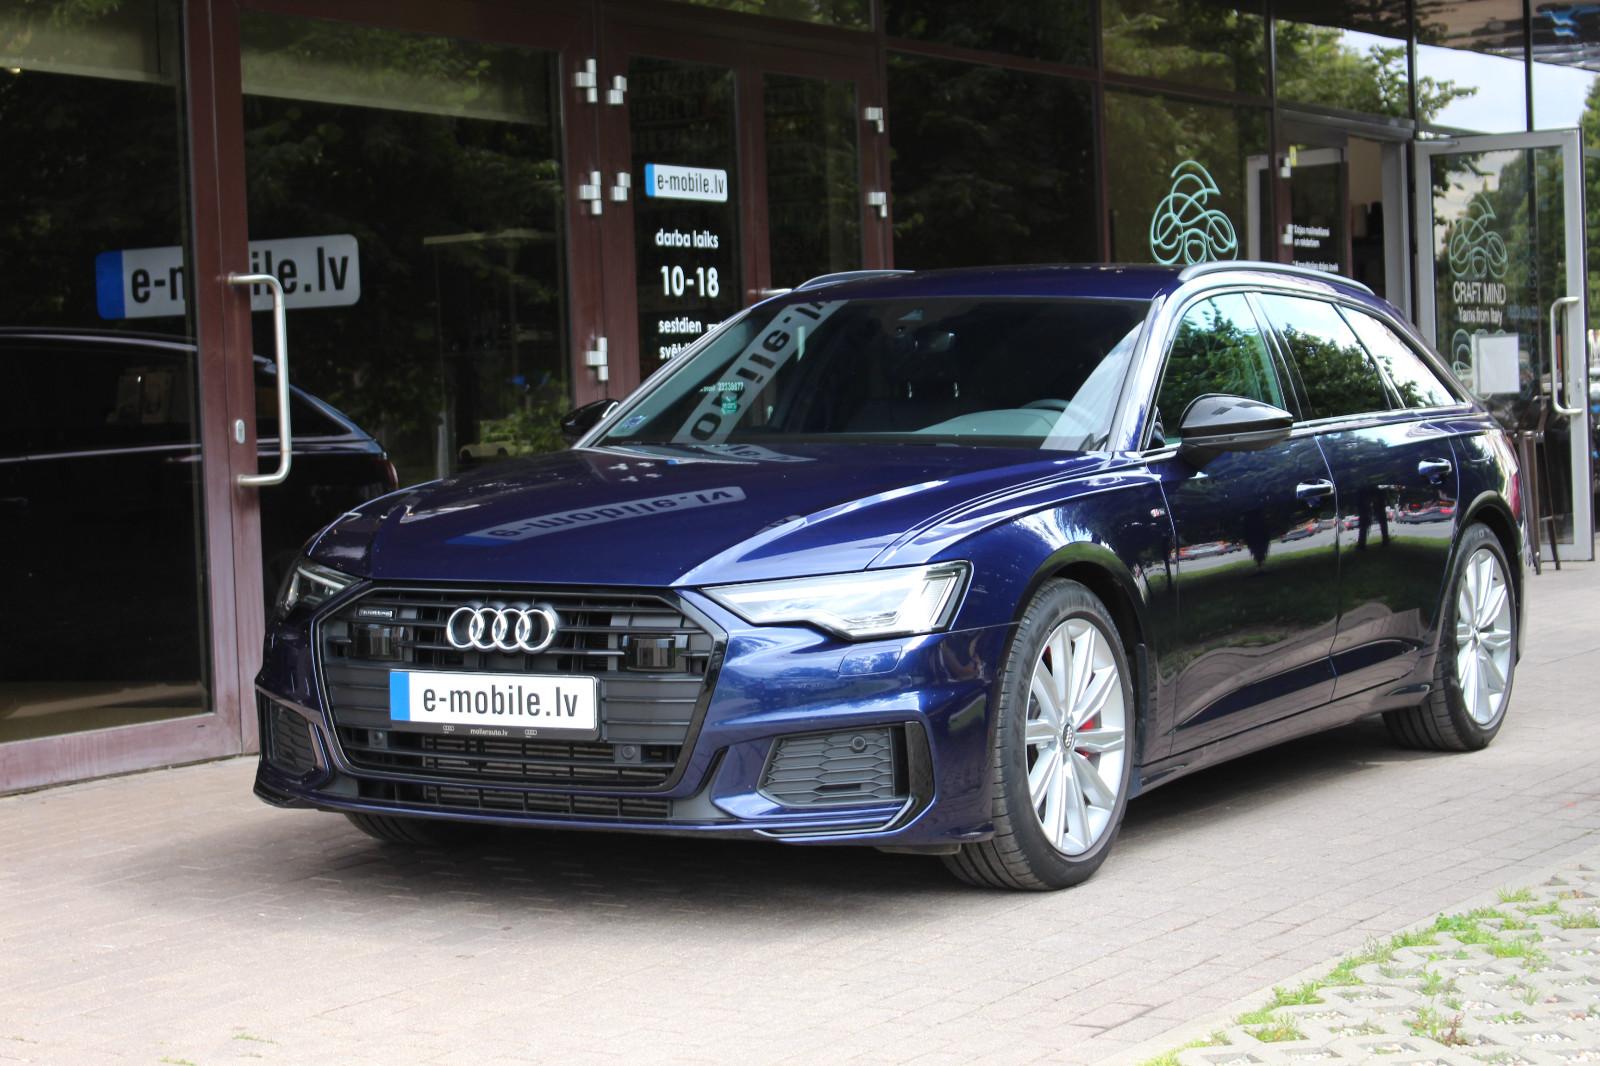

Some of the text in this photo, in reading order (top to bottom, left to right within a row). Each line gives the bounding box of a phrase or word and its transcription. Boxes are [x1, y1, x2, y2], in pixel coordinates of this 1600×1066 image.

[657, 172, 724, 194] e-mobile.lv
[655, 227, 719, 249] darba laiks
[131, 246, 348, 303] e-ile.lv
[660, 265, 719, 297] 10-18
[1453, 281, 1506, 305] CRAFT MIND
[658, 316, 702, 334] sestdien
[423, 684, 578, 717] e-mobile.lv
